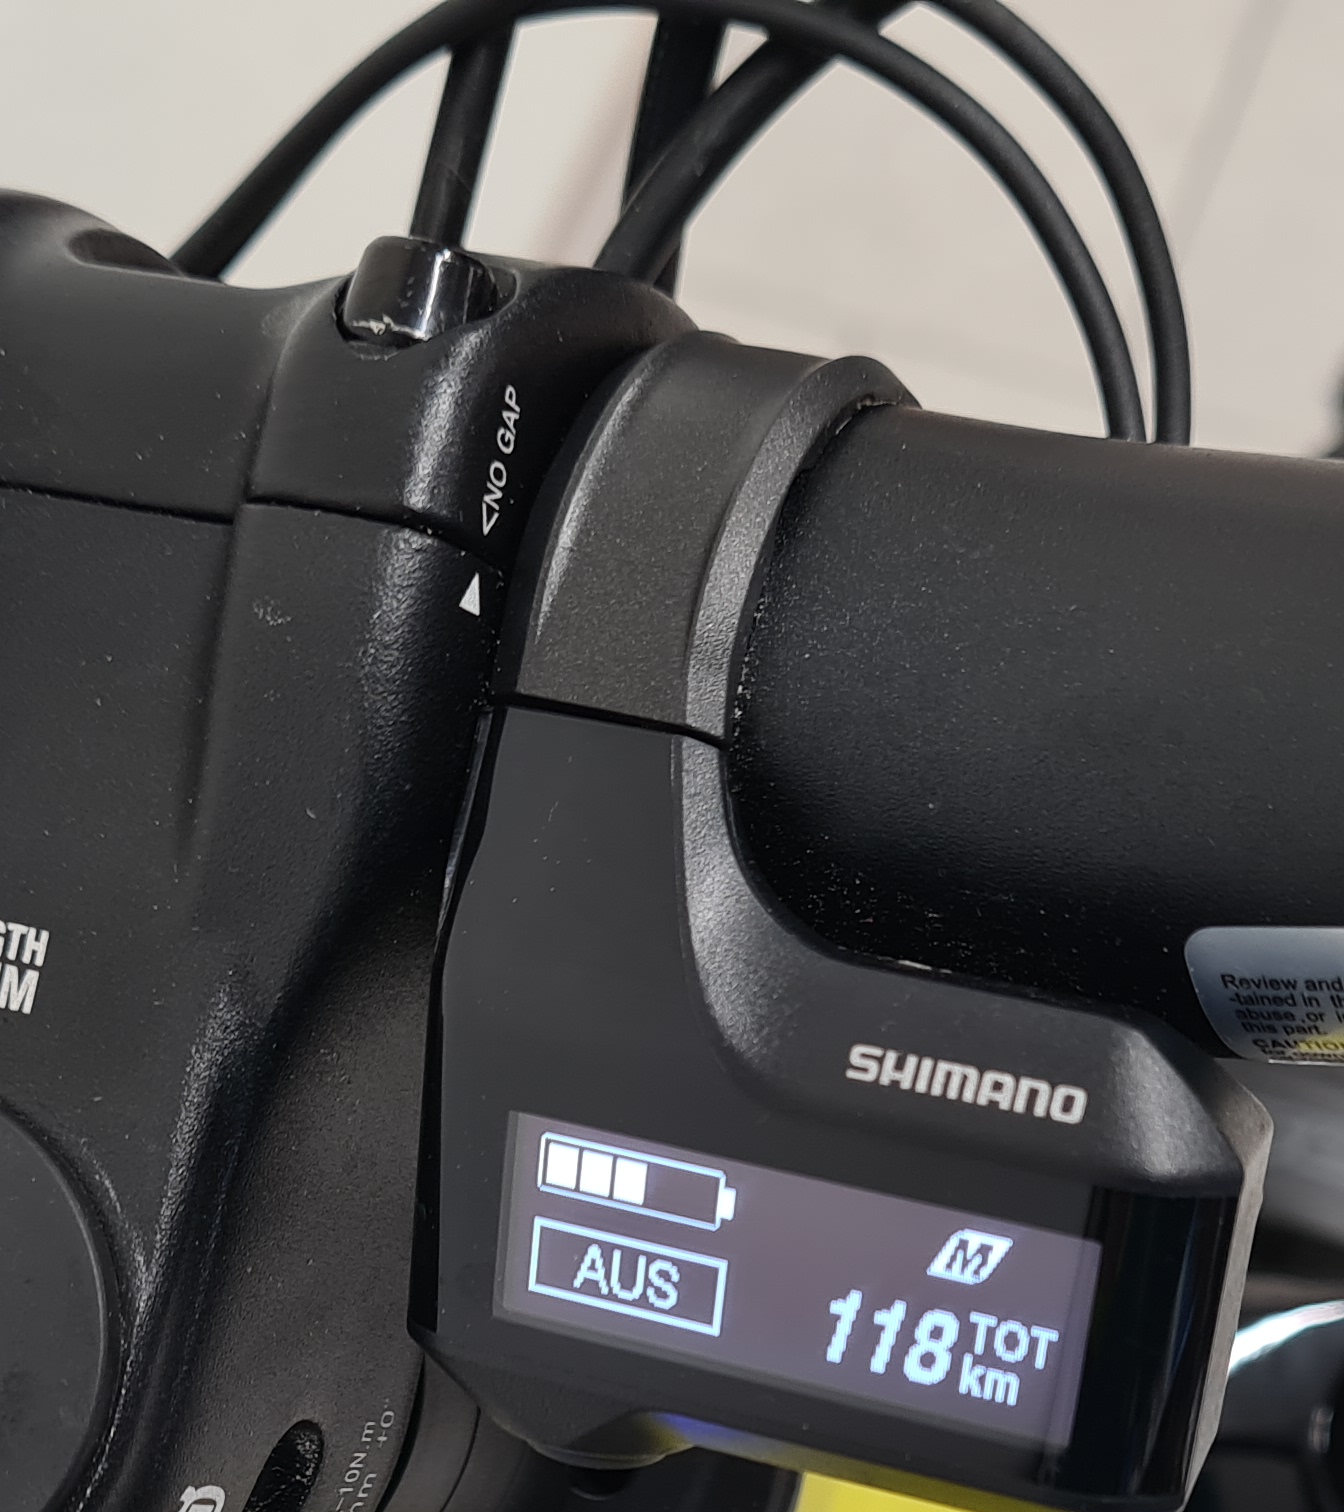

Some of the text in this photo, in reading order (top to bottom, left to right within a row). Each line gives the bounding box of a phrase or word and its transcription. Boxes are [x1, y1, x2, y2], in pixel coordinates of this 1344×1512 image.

[483, 385, 521, 511] NO GAP
[1220, 973, 1298, 991] Review
[1304, 976, 1344, 992] and
[1301, 993, 1321, 1008] in
[1241, 1021, 1277, 1034] this
[846, 1043, 1088, 1124] SHIMANO
[571, 1244, 680, 1311] AUS
[826, 1289, 1059, 1406] 118 TOT km
